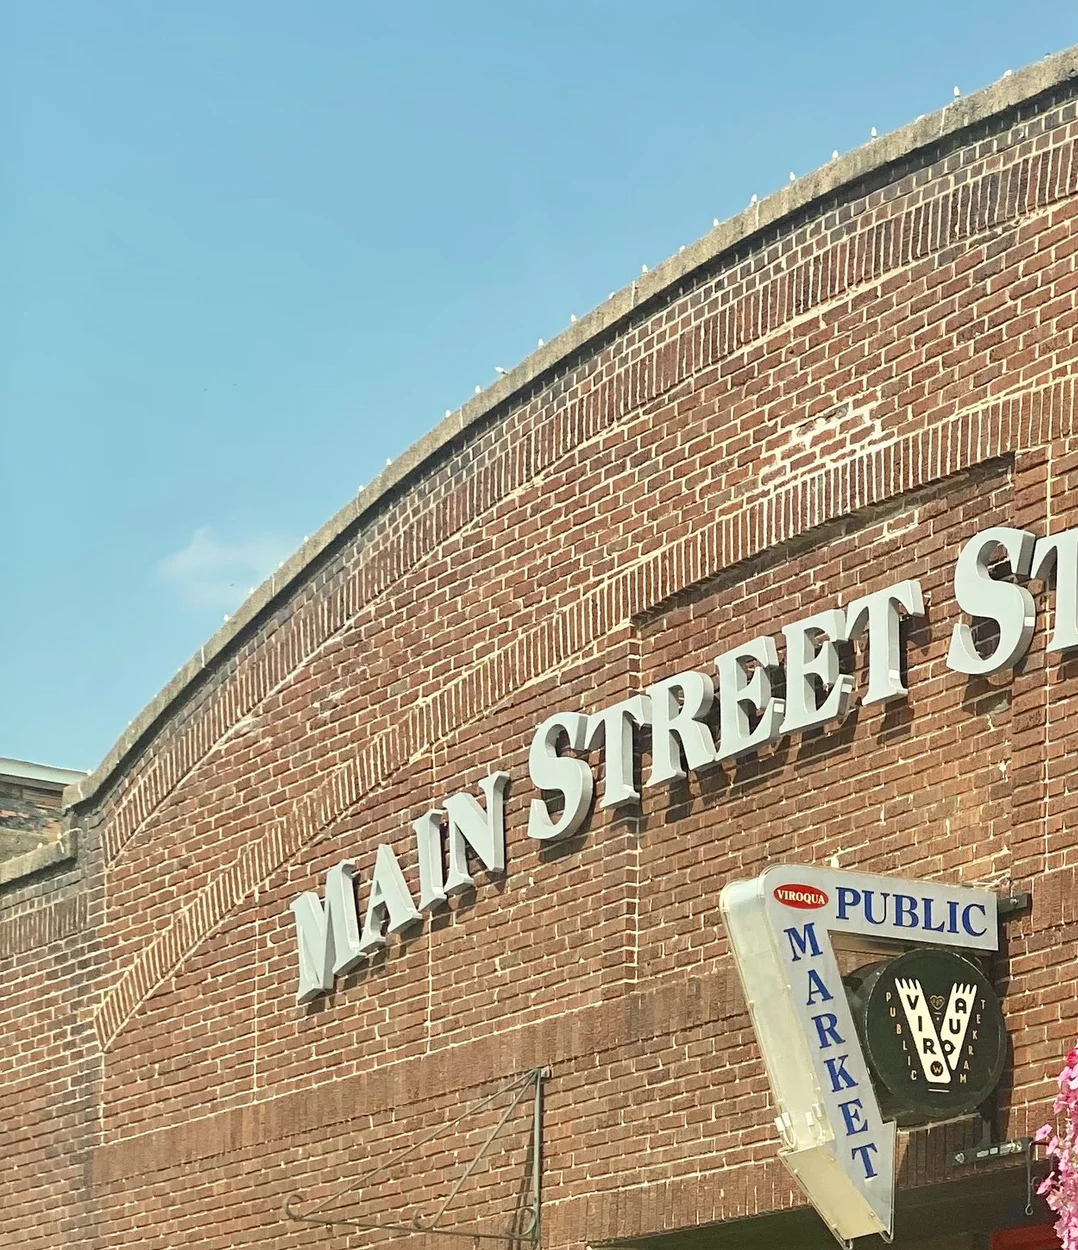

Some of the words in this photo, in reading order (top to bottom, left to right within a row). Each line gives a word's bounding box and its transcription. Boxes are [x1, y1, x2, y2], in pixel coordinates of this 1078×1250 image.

[290, 769, 510, 1002] MAIN
[527, 580, 925, 842] STREET
[776, 888, 827, 906] VIROQUA
[835, 886, 988, 938] PUBLIC
[783, 922, 879, 1180] MARKET
